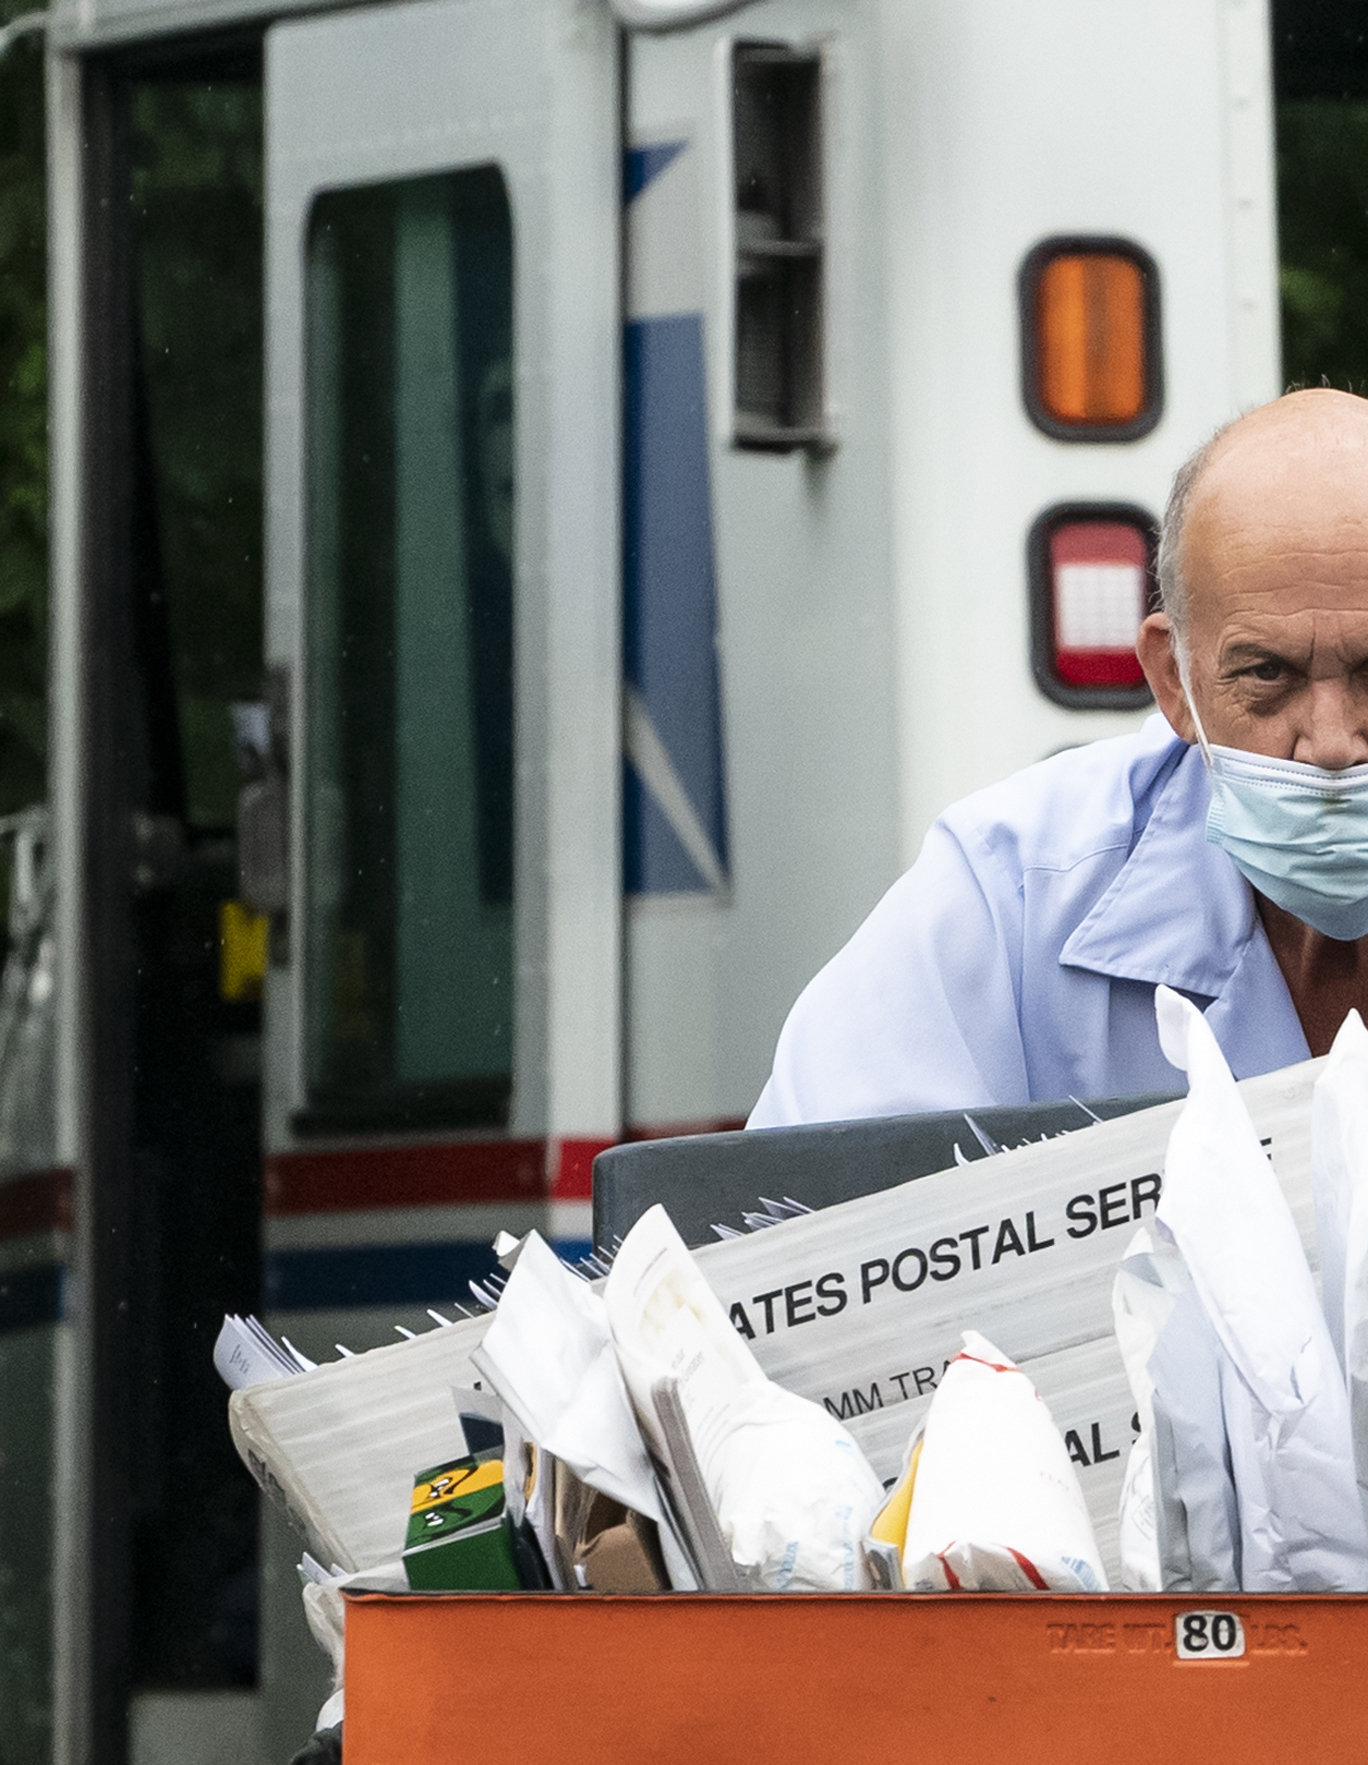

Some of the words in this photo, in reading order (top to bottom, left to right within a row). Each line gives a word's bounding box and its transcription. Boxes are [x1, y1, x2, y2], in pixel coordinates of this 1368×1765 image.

[861, 1211, 1054, 1304] POSTAL
[1066, 1172, 1164, 1238] SER
[1182, 1614, 1237, 1653] 80
